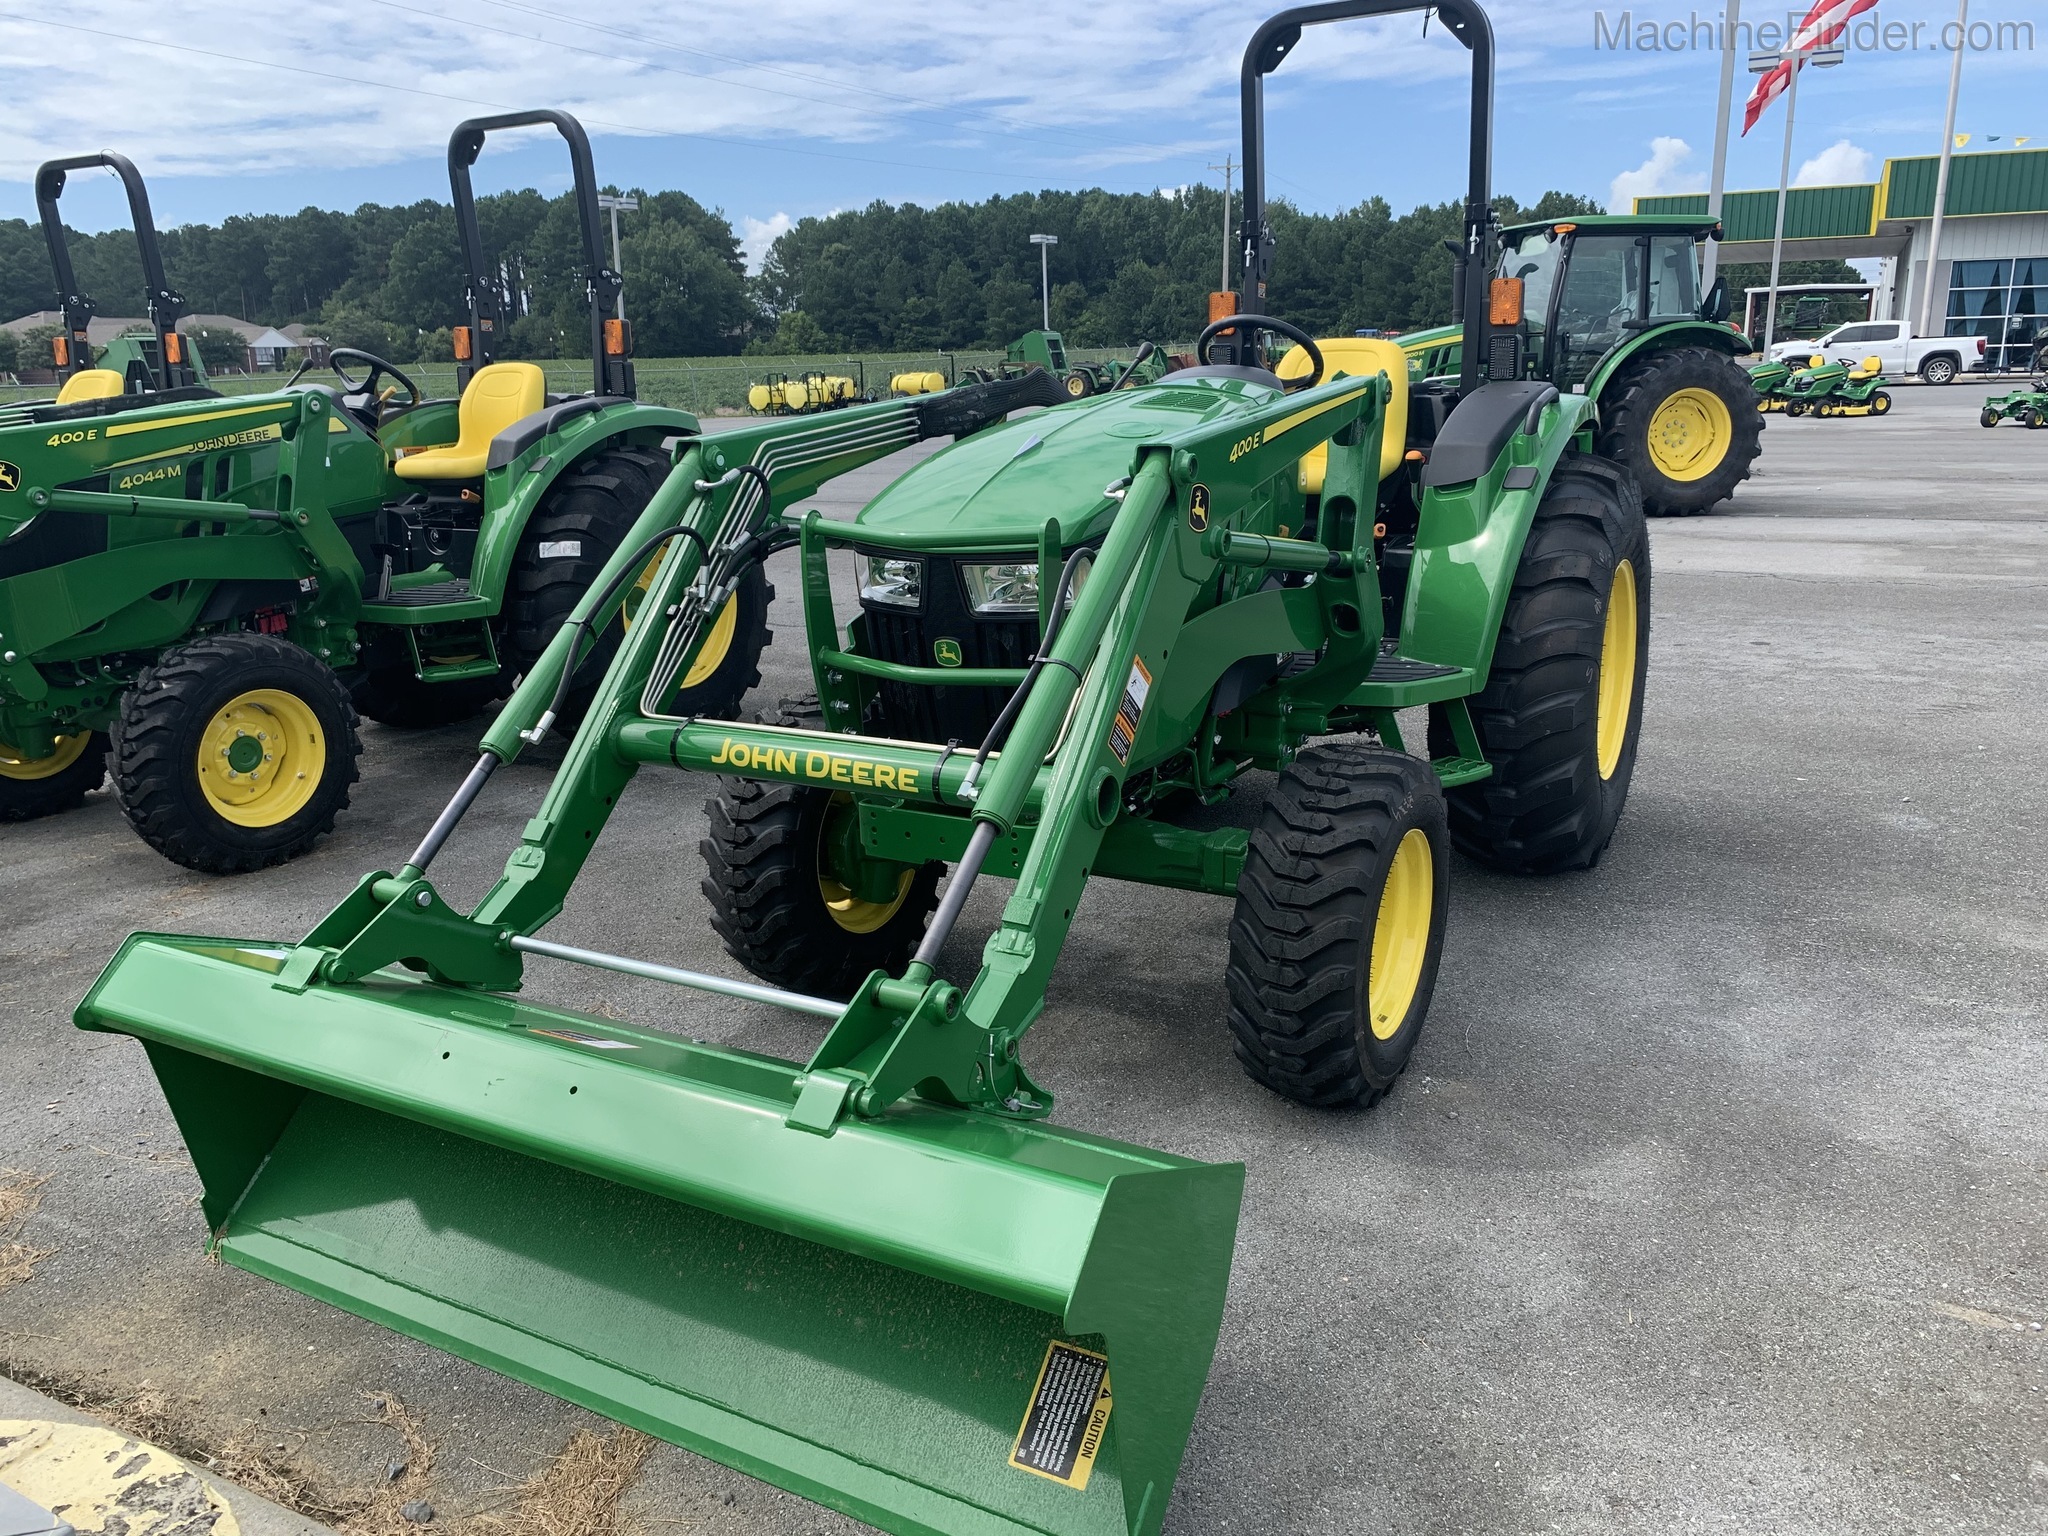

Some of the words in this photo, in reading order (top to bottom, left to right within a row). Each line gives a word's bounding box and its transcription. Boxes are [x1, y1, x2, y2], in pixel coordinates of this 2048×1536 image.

[188, 436, 225, 452] JOHN
[227, 430, 271, 445] DEERE
[711, 738, 797, 775] JOHN
[806, 750, 920, 793] DEERE
[1077, 1394, 1085, 1404] and
[1039, 1409, 1048, 1421] drive
[1064, 1403, 1074, 1419] bucket
[1049, 1422, 1059, 1440] position
[1052, 1429, 1065, 1450] shipping
[1065, 1423, 1074, 1441] caution
[1081, 1409, 1105, 1459] CAUTION
[1038, 1439, 1053, 1468] immediately
[1060, 1440, 1068, 1454] while
